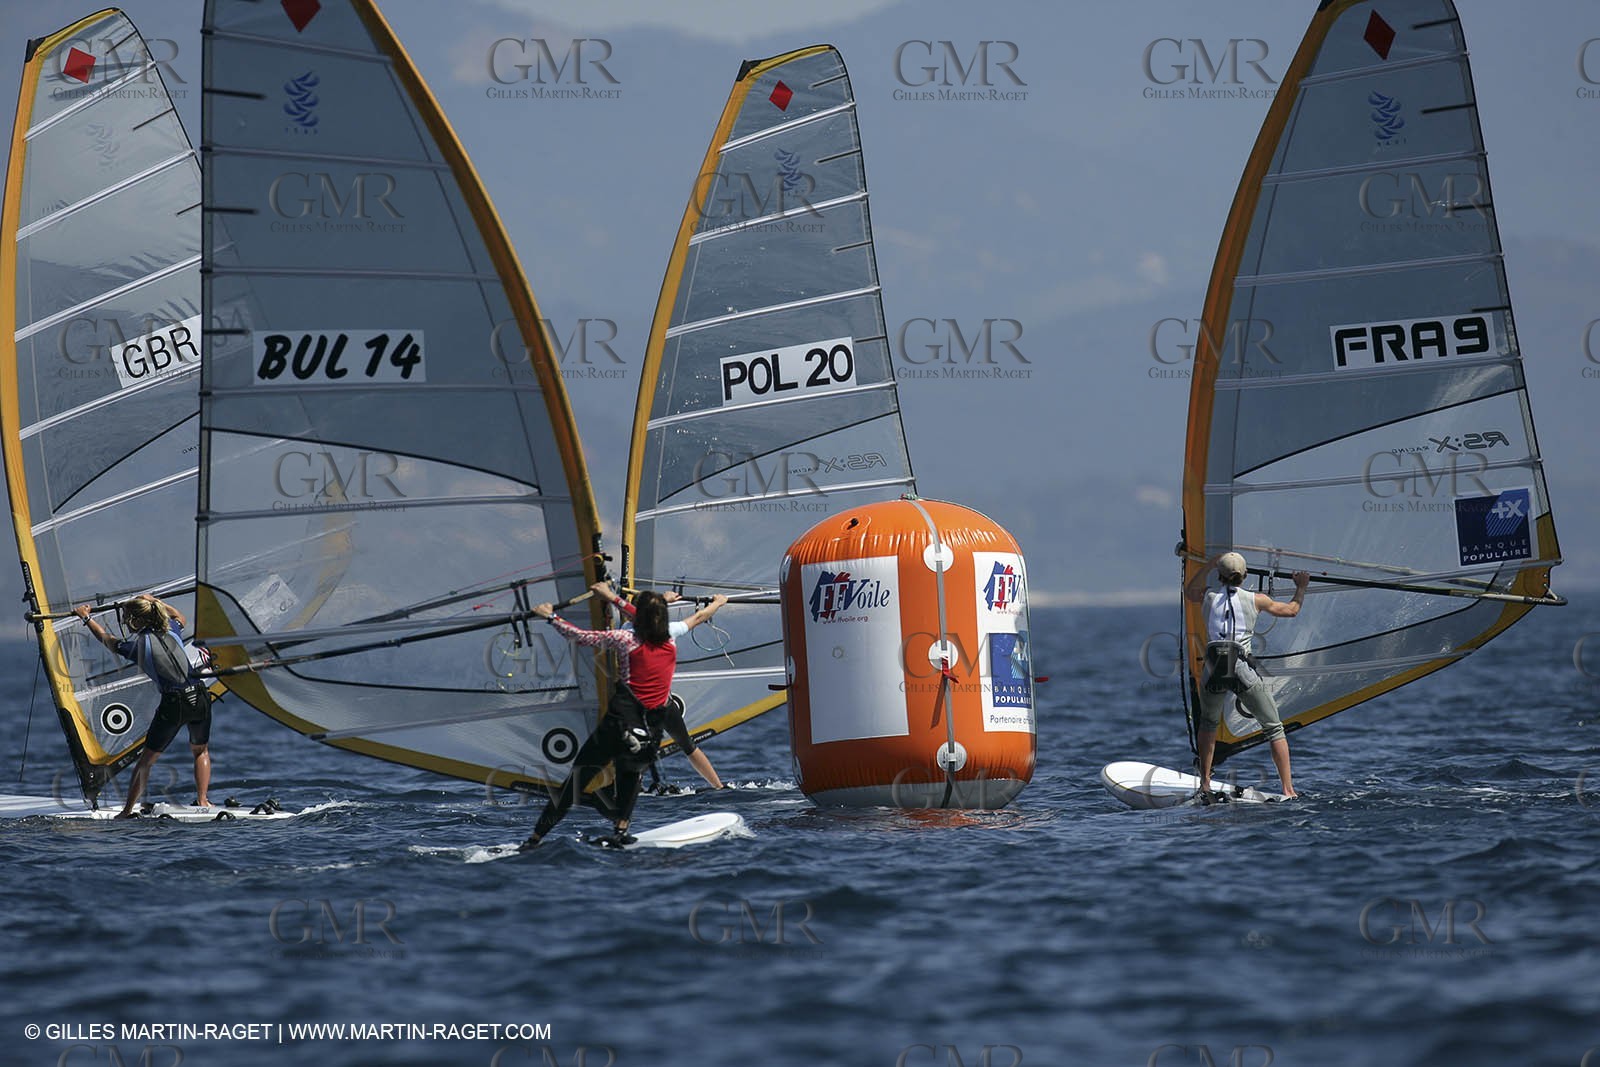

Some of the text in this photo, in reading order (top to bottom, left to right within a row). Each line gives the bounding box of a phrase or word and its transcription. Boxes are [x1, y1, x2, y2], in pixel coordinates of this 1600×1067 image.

[122, 326, 200, 379] GBR
[257, 333, 421, 380] BUL 14
[1334, 316, 1490, 367] FRA 9
[723, 344, 854, 400] POL 20
[1462, 539, 1527, 553] BANQUE
[1463, 548, 1529, 562] POPULAIRE
